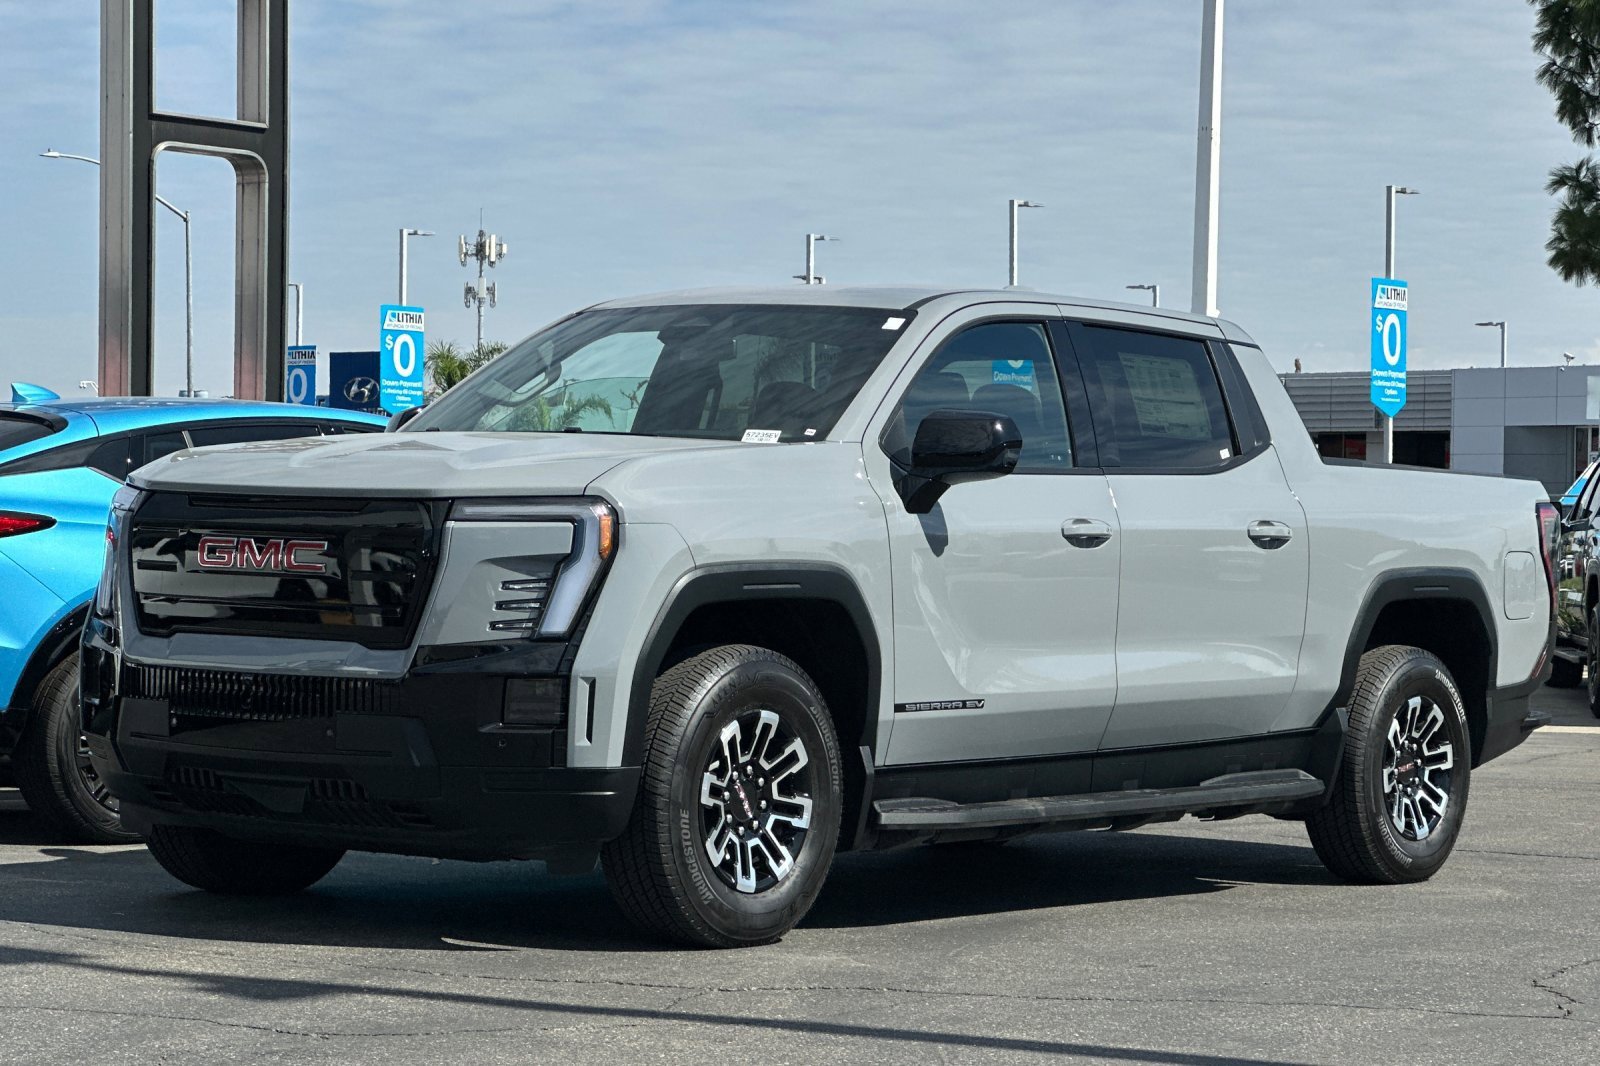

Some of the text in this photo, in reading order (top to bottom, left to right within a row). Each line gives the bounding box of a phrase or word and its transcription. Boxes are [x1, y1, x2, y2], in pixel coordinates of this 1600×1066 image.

[1386, 287, 1407, 302] LITHIA
[397, 312, 423, 324] LITHIA
[291, 350, 316, 359] LITHIA
[1372, 368, 1388, 377] Down
[381, 378, 399, 387] Down
[197, 536, 328, 573] GMC
[905, 700, 985, 712] SIERRA EV
[679, 808, 715, 905] BRIDGESTONE
